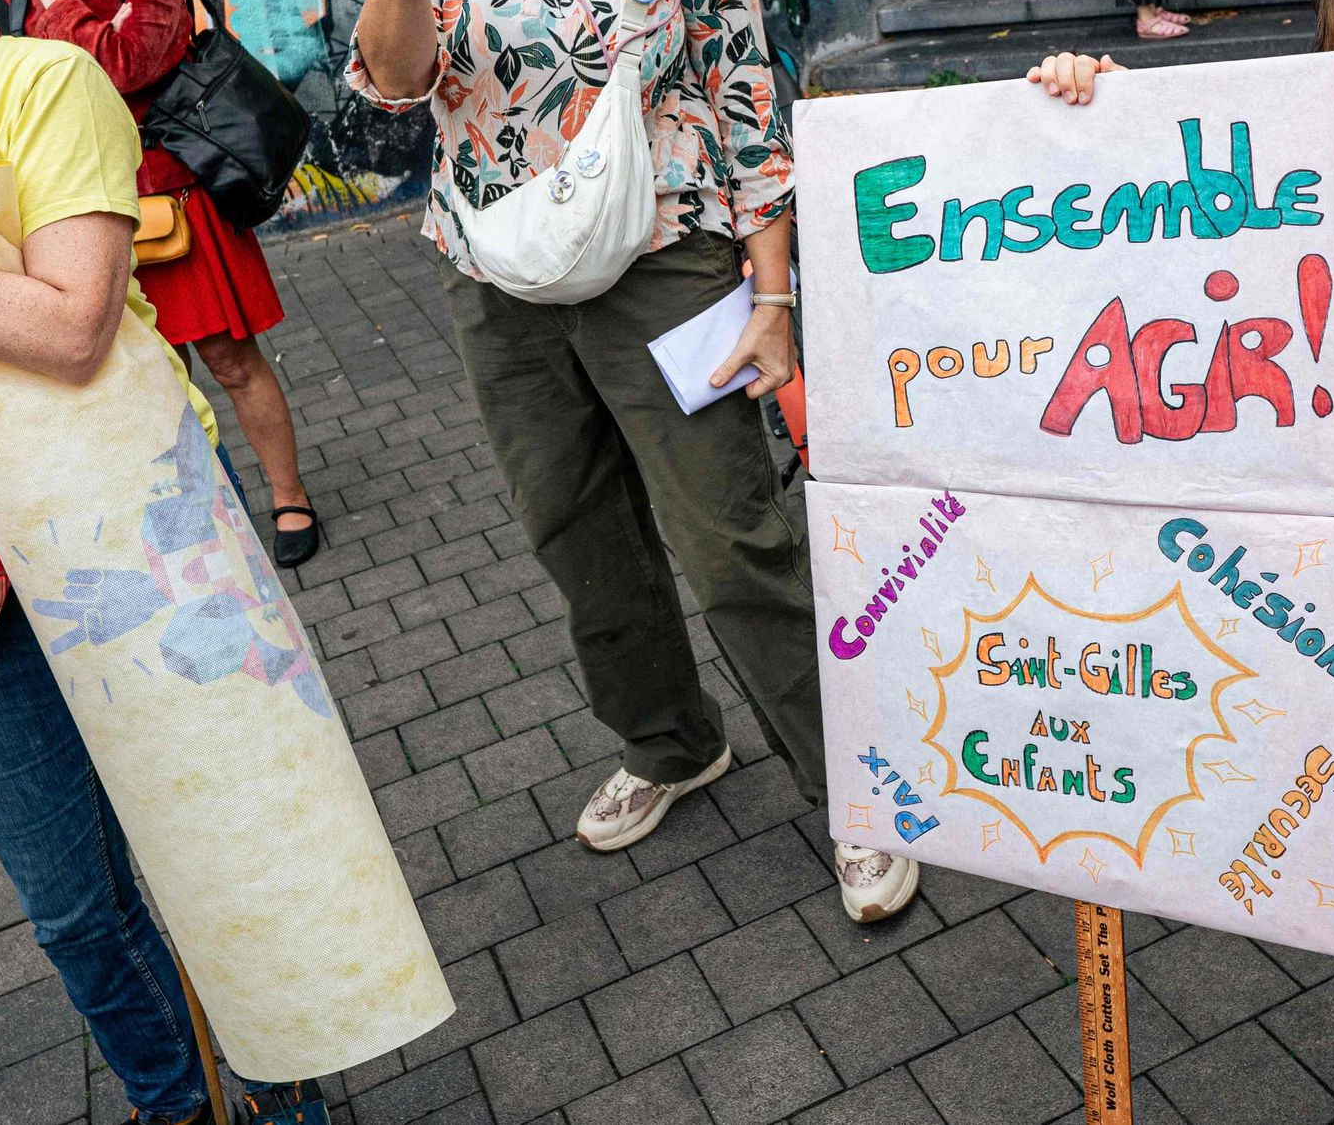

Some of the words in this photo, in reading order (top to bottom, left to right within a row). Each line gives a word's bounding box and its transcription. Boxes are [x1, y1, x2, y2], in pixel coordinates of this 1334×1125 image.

[854, 118, 1323, 274] Ensemble
[888, 336, 1054, 427] pour
[1097, 922, 1109, 948] The
[1099, 953, 1111, 977] Set
[1101, 983, 1115, 1033] Cutters
[1103, 1039, 1115, 1075] Cloth
[1105, 1078, 1117, 1112] Wolf
